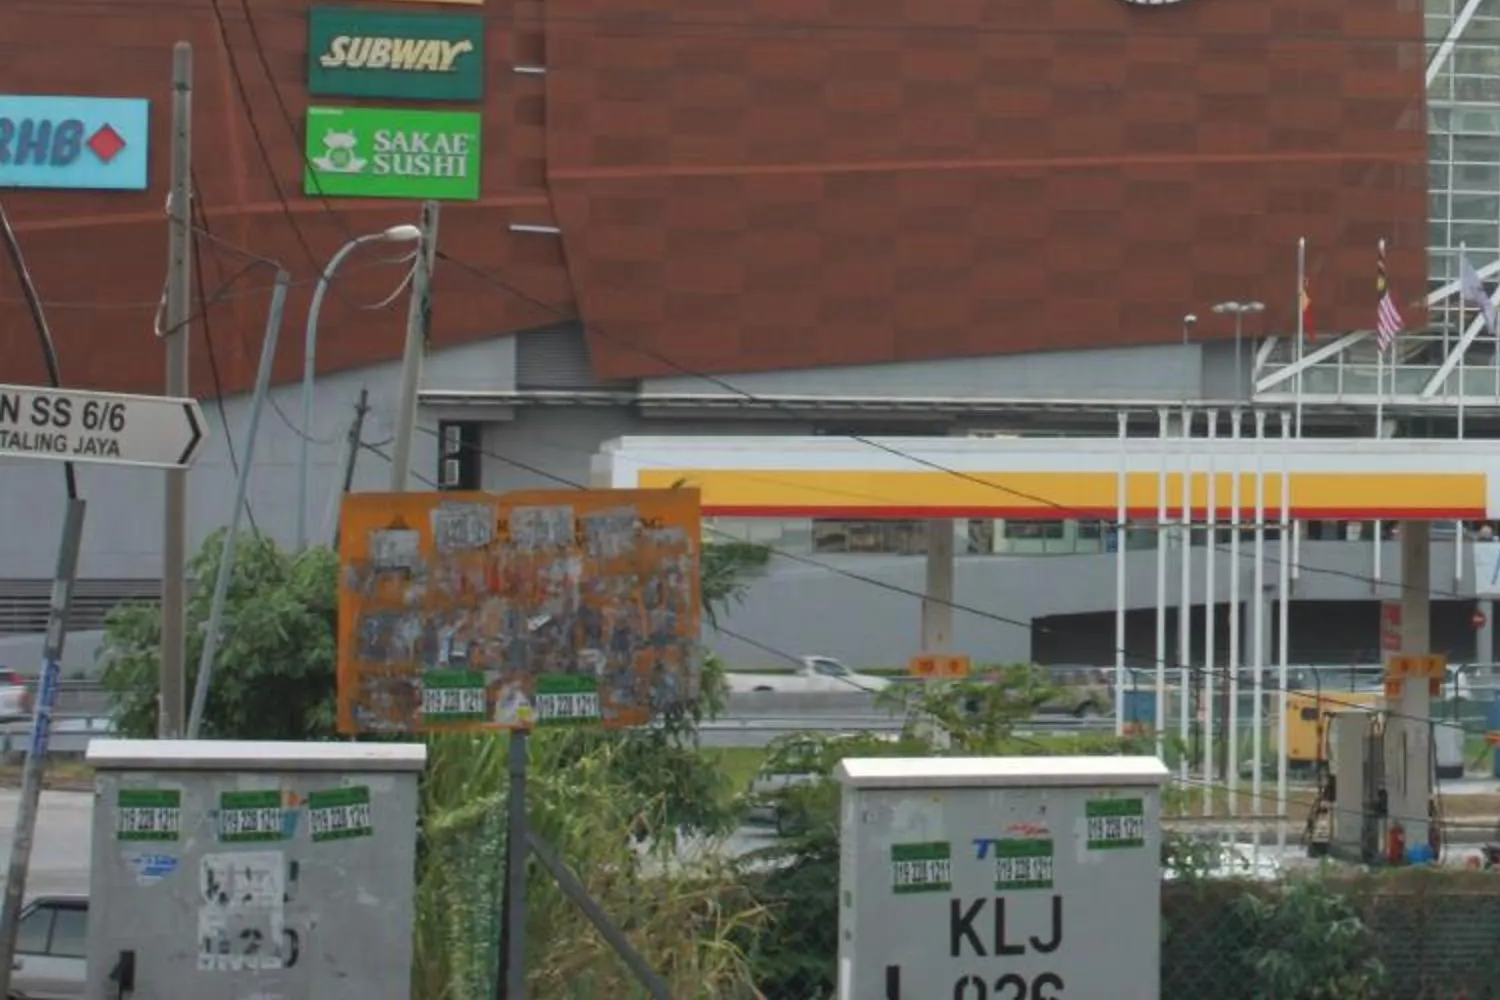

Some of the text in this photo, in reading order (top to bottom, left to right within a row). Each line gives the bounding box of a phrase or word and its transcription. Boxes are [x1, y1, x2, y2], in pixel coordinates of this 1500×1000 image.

[320, 35, 473, 71] SUBWAY
[373, 129, 469, 153] SAKAE
[372, 153, 466, 177] SUSHI
[31, 396, 71, 427] SS
[82, 401, 126, 432] 6/6
[73, 437, 120, 456] JAYA
[951, 894, 1062, 957] KLJ
